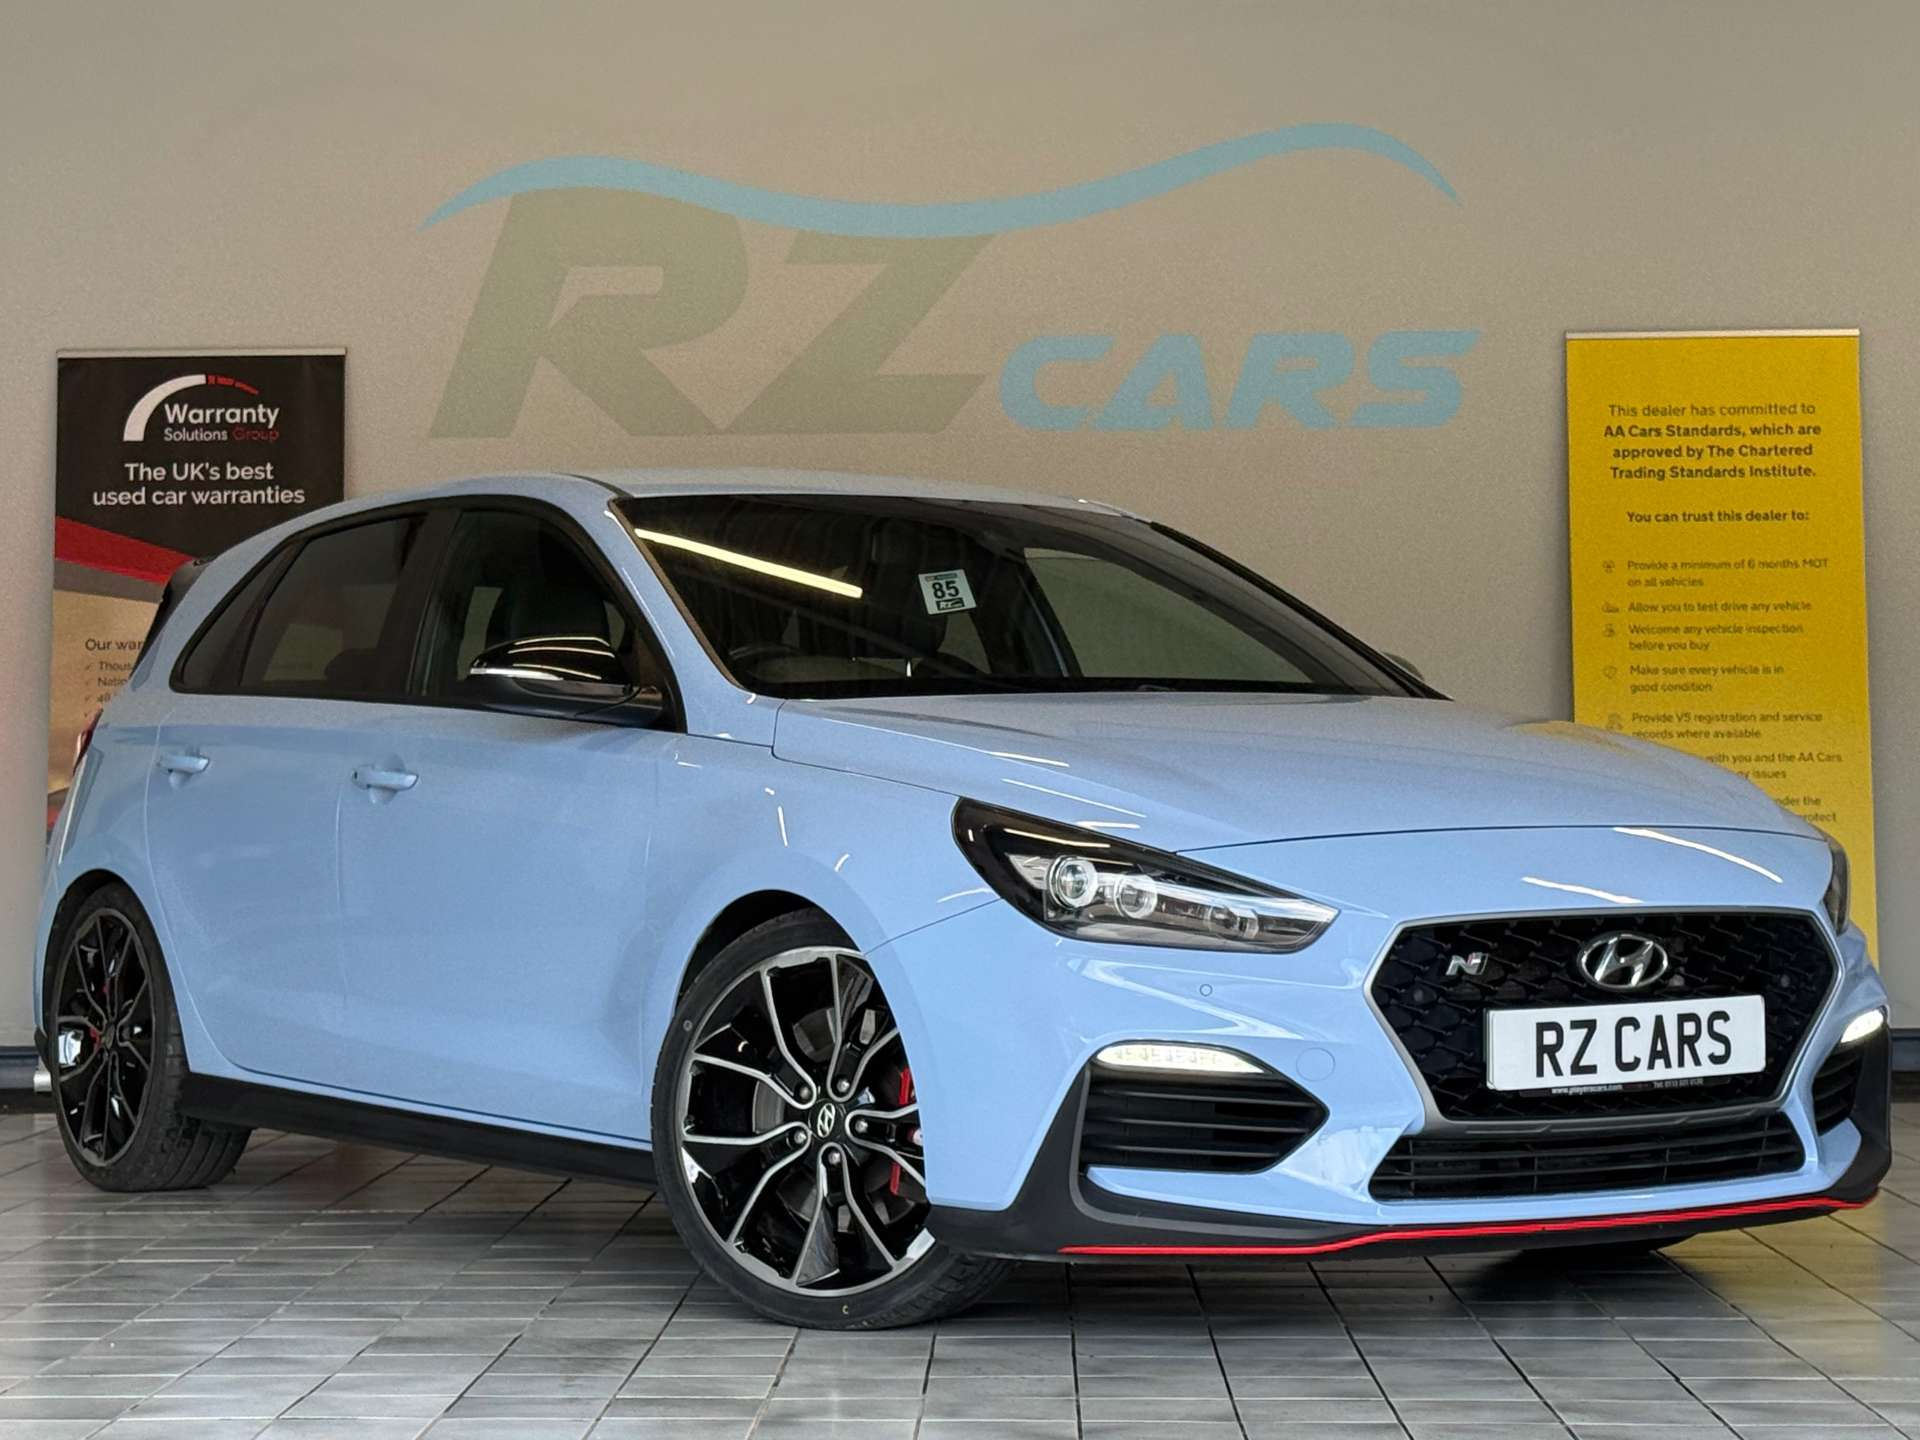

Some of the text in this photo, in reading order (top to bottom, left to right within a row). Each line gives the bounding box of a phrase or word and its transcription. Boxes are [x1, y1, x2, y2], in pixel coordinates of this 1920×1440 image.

[428, 188, 1482, 438] RZ CARS
[1609, 402, 1816, 417] This dealer has committed to
[164, 404, 279, 429] Warranty
[163, 427, 280, 443] Solutions Group
[1603, 424, 1821, 438] AA Cars Standards, which are
[1612, 444, 1813, 460] approved by The Chartered
[125, 462, 274, 481] The UK's best
[1610, 465, 1816, 481] Trading Standards Institute.
[93, 486, 305, 506] used car warranties
[1626, 510, 1809, 523] You can trust this dealer to:
[1627, 560, 1668, 571] Provide
[1670, 562, 1678, 570] a
[1680, 560, 1731, 570] minimum
[1734, 559, 1745, 570] of
[1758, 559, 1799, 569] months
[1802, 558, 1828, 569] MOT
[1627, 577, 1704, 587] on all vehicles
[932, 580, 959, 599] 85
[1628, 601, 1812, 614] Allow you to test drive any vehicle
[1629, 624, 1803, 636] Welcome any vehicle inspection
[85, 638, 145, 651] Our war
[1629, 640, 1709, 652] before you buy
[1630, 665, 1784, 677] Make sure every vehicle is in
[1630, 682, 1712, 694] good condition
[1632, 711, 1823, 724] Provide V5 registration and service
[1632, 728, 1761, 739] records where available
[1732, 754, 1752, 764] you
[1754, 752, 1775, 762] and
[1777, 752, 1794, 762] the
[1799, 752, 1815, 762] AA
[1817, 752, 1842, 762] Cars
[1752, 770, 1786, 780] issues
[1803, 796, 1821, 806] the
[1535, 1010, 1731, 1078] RZ CARS
